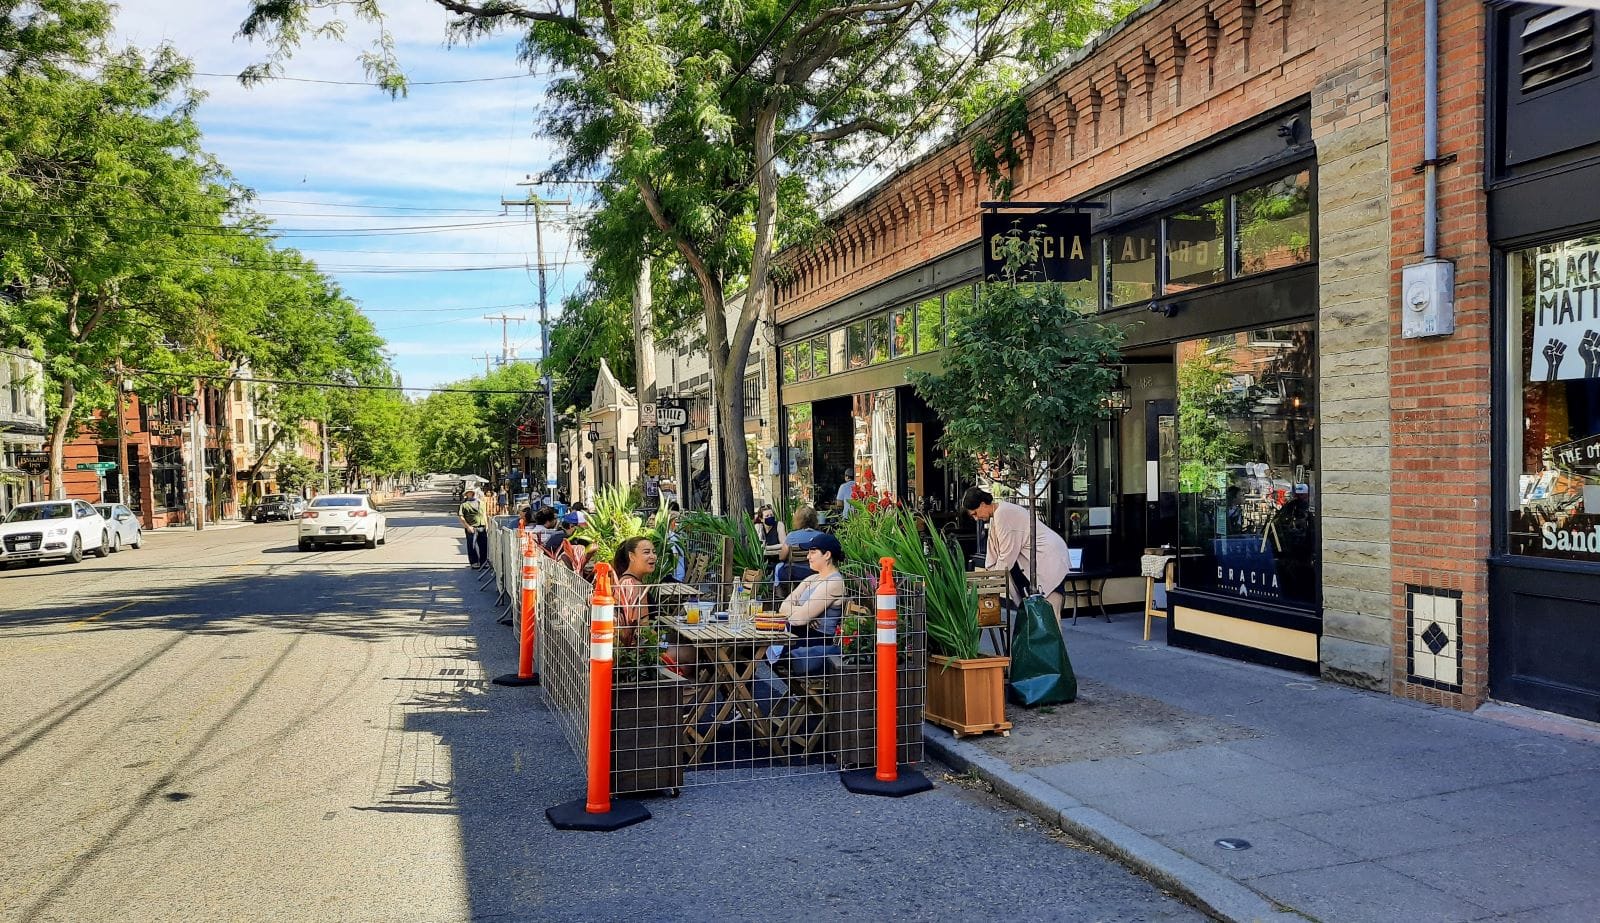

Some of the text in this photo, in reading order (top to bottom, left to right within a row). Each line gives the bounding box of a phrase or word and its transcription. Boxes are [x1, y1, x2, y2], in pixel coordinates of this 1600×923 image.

[991, 234, 1084, 260] GACIA
[1540, 250, 1600, 292] BLACK
[1559, 447, 1582, 464] THE
[1542, 522, 1600, 553] Sand
[1217, 566, 1278, 588] GRACIA
